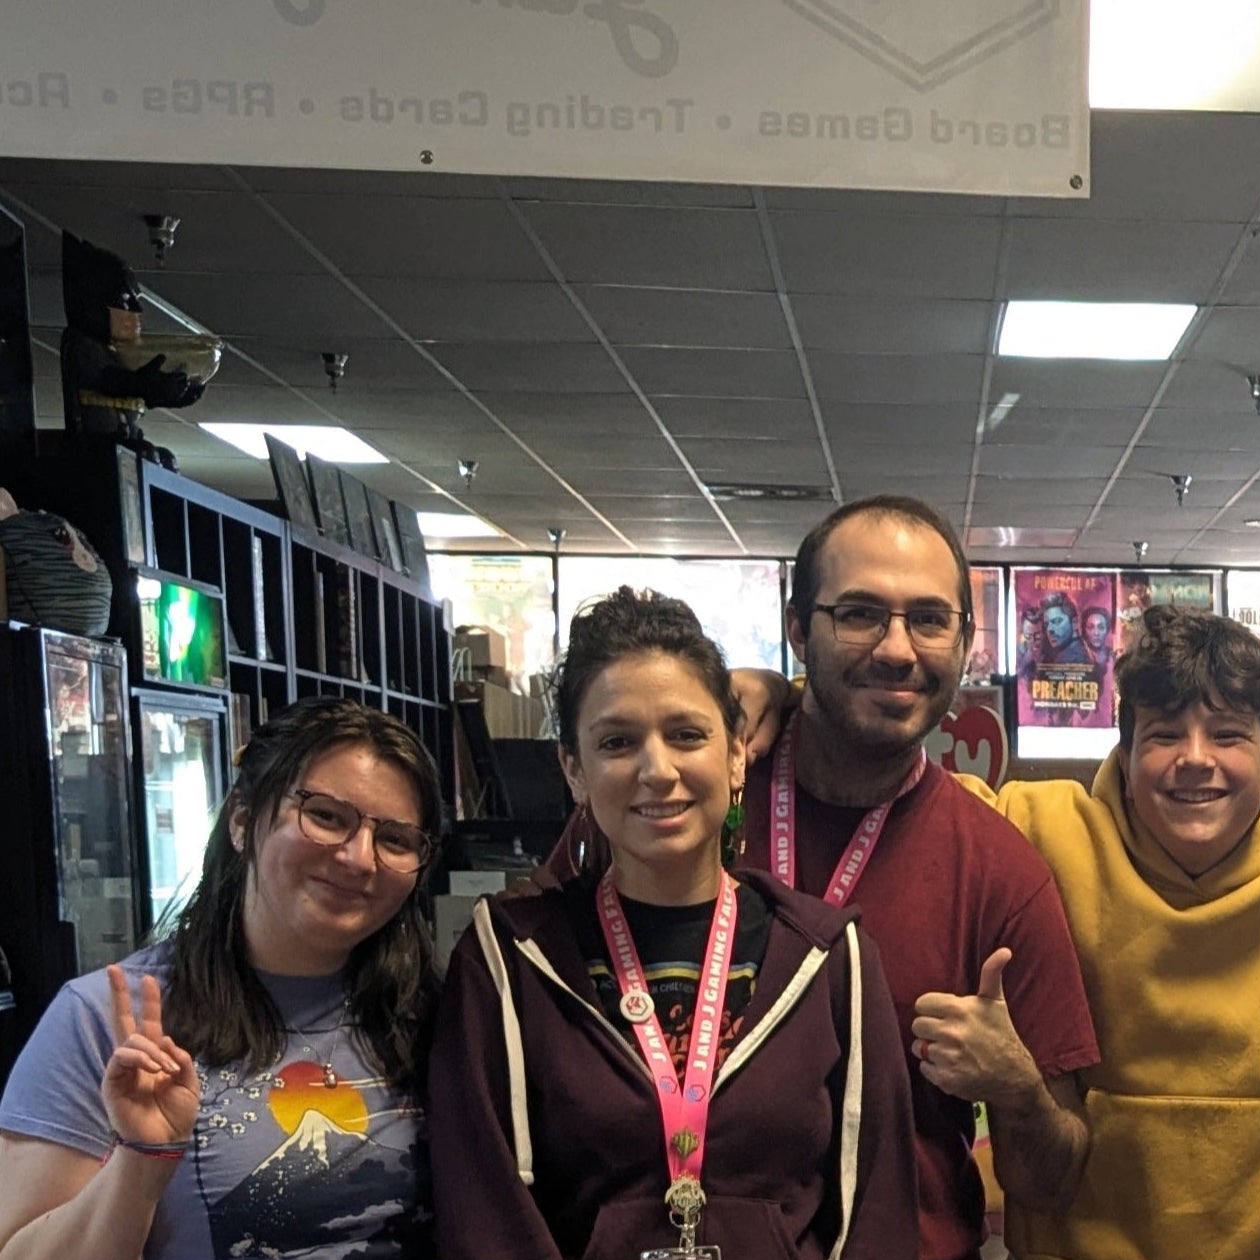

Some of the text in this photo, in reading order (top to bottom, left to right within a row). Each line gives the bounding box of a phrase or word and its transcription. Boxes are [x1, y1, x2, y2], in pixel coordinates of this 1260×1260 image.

[1032, 680, 1099, 701] PREACHER
[778, 837, 788, 874] AND
[833, 803, 884, 900] J AND J GA
[704, 931, 727, 1002] GAMING
[702, 1005, 716, 1017] J
[697, 1022, 714, 1056] AND
[651, 1050, 667, 1062] J
[693, 1059, 708, 1071] J
